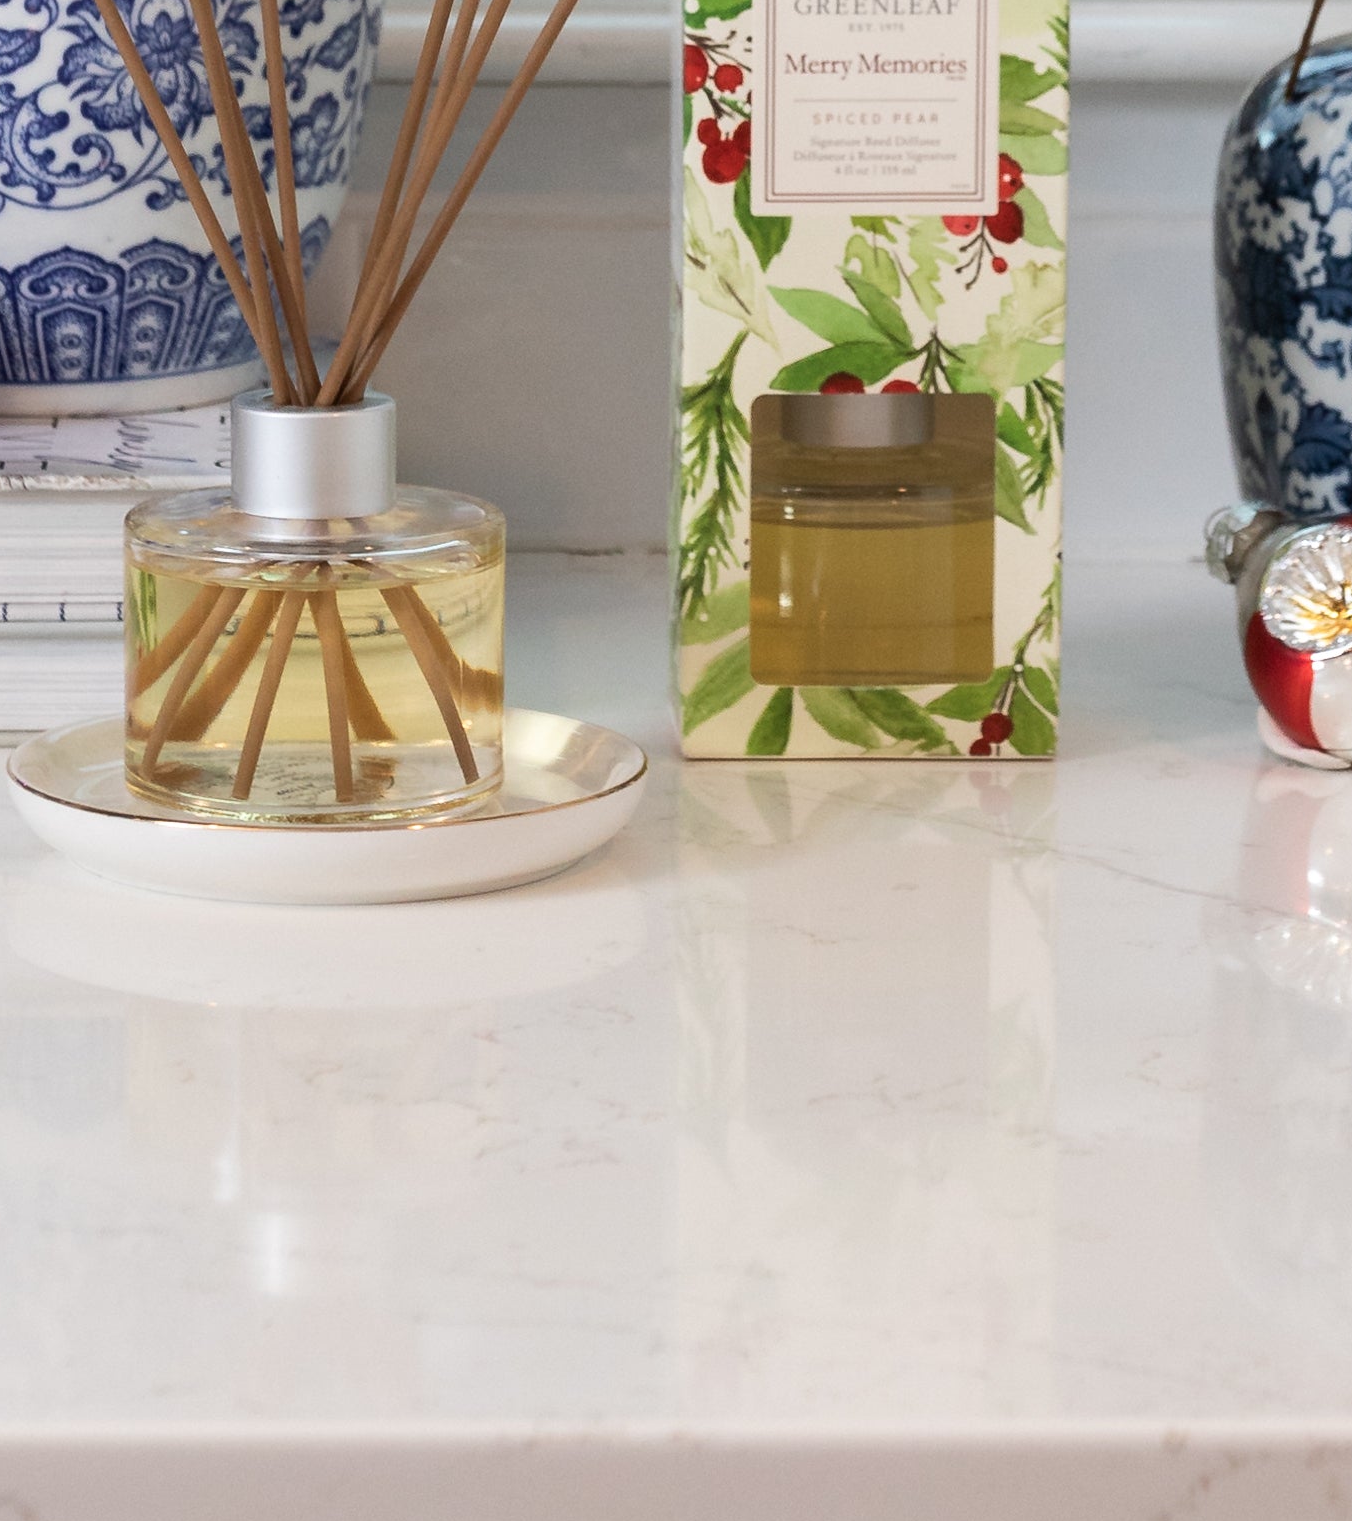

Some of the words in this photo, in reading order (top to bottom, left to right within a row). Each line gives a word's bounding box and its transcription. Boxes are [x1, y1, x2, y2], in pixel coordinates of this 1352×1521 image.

[784, 53, 851, 81] Merry
[859, 52, 968, 75] Memories
[812, 112, 882, 125] SPICED
[893, 112, 939, 125] PEAR
